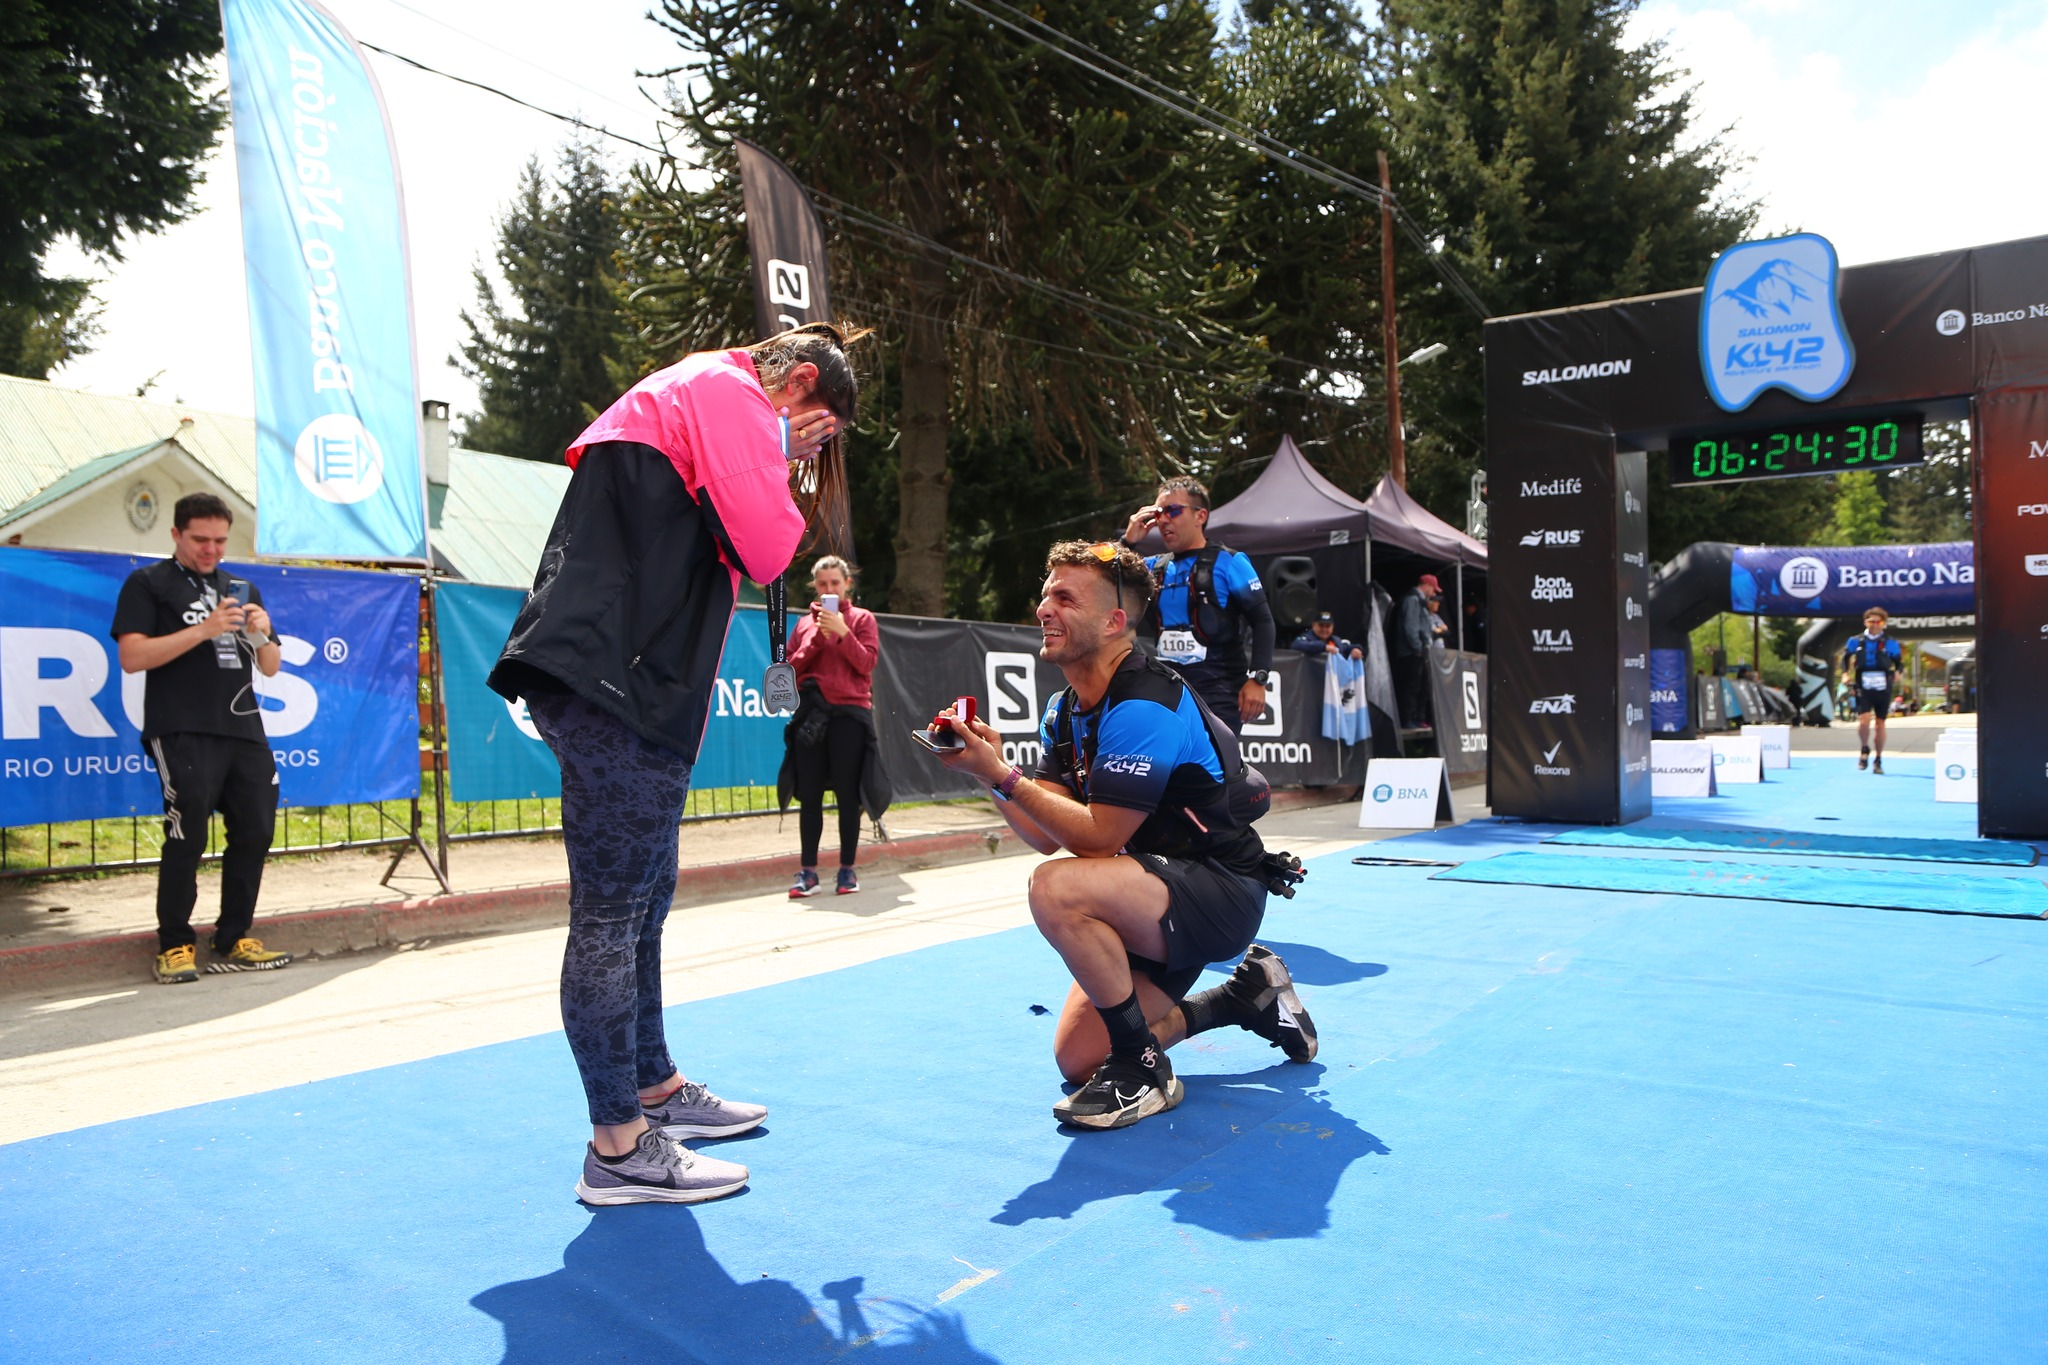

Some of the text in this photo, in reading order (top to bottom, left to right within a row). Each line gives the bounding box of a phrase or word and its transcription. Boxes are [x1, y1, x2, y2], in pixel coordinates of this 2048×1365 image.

[1971, 309, 2026, 326] Banco
[1738, 323, 1811, 337] SALOMON
[1522, 359, 1632, 386] SALOMON
[1692, 422, 1899, 477] 06:24:30
[1520, 478, 1582, 497] Medifé
[1838, 565, 1927, 587] Banco
[1531, 587, 1573, 603] aqua
[1532, 629, 1573, 645] VLA
[1162, 639, 1195, 652] 1105
[1529, 700, 1574, 713] ENA
[1239, 742, 1312, 763] lomon
[4, 753, 158, 779] RIO URUGU
[1534, 764, 1570, 776] Rexona
[1397, 788, 1428, 800] BNA
